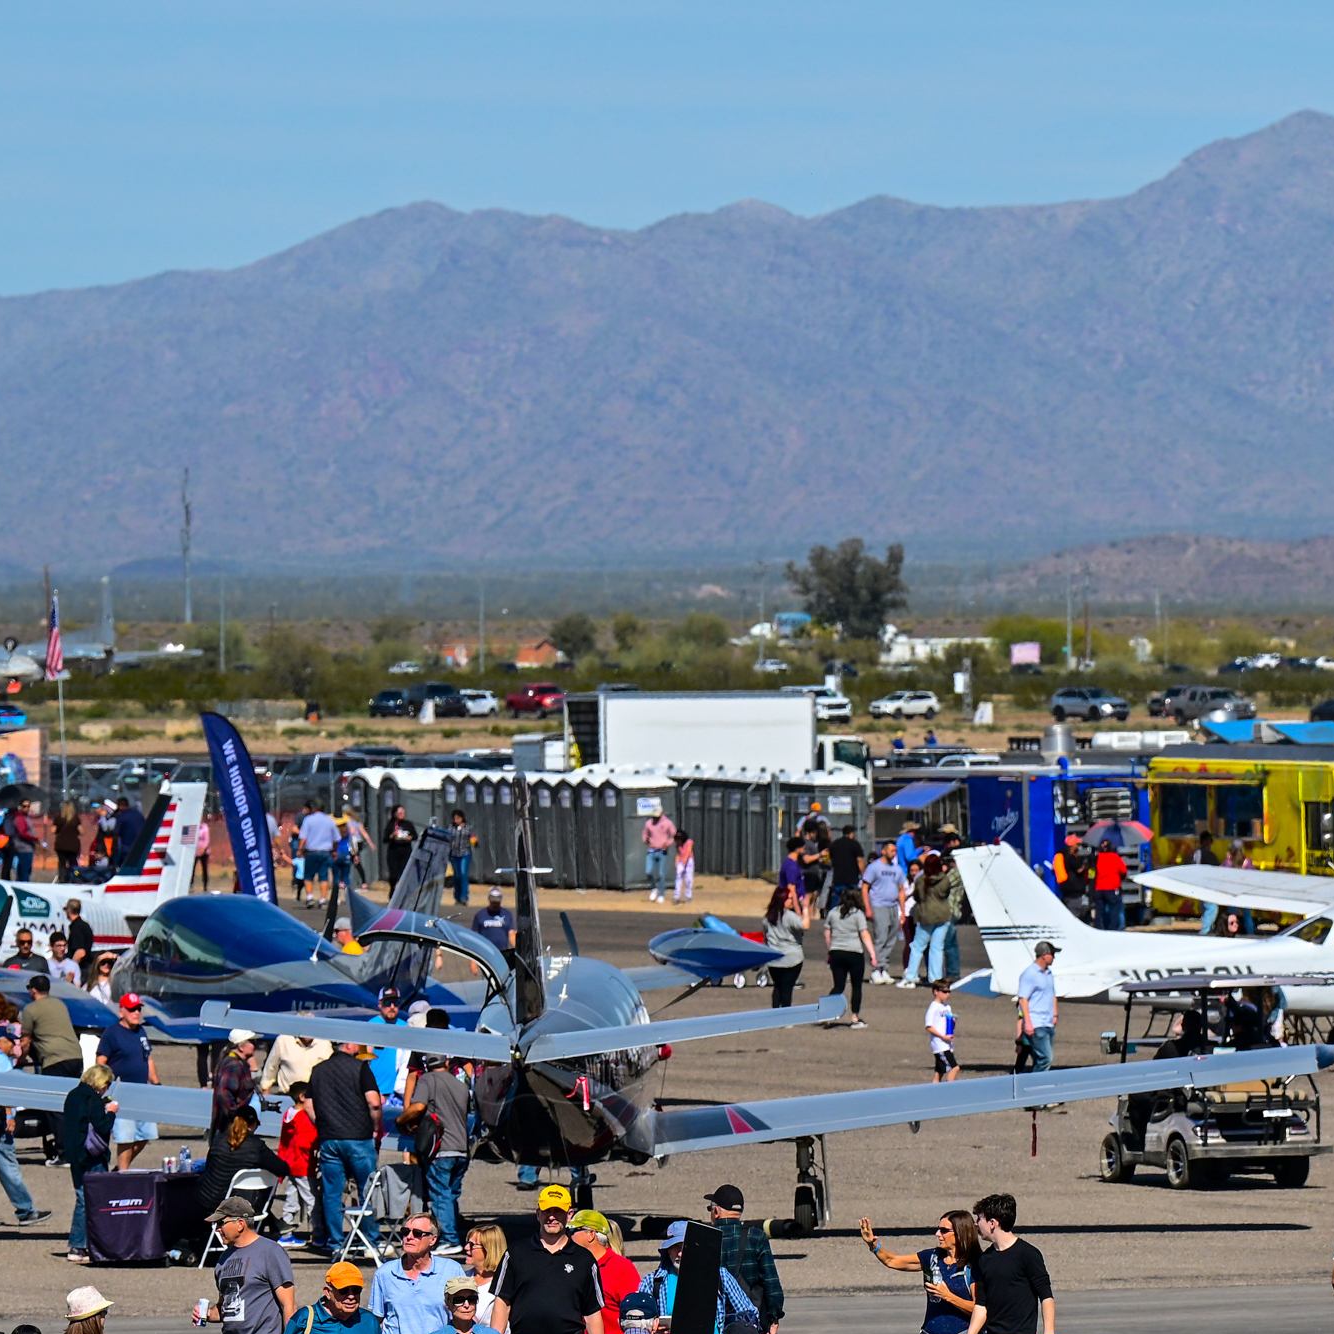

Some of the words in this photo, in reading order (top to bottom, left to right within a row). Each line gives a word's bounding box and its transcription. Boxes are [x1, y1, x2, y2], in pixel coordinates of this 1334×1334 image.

[221, 738, 237, 765] WE
[228, 764, 250, 818] HONOR
[240, 817, 257, 850] OUR
